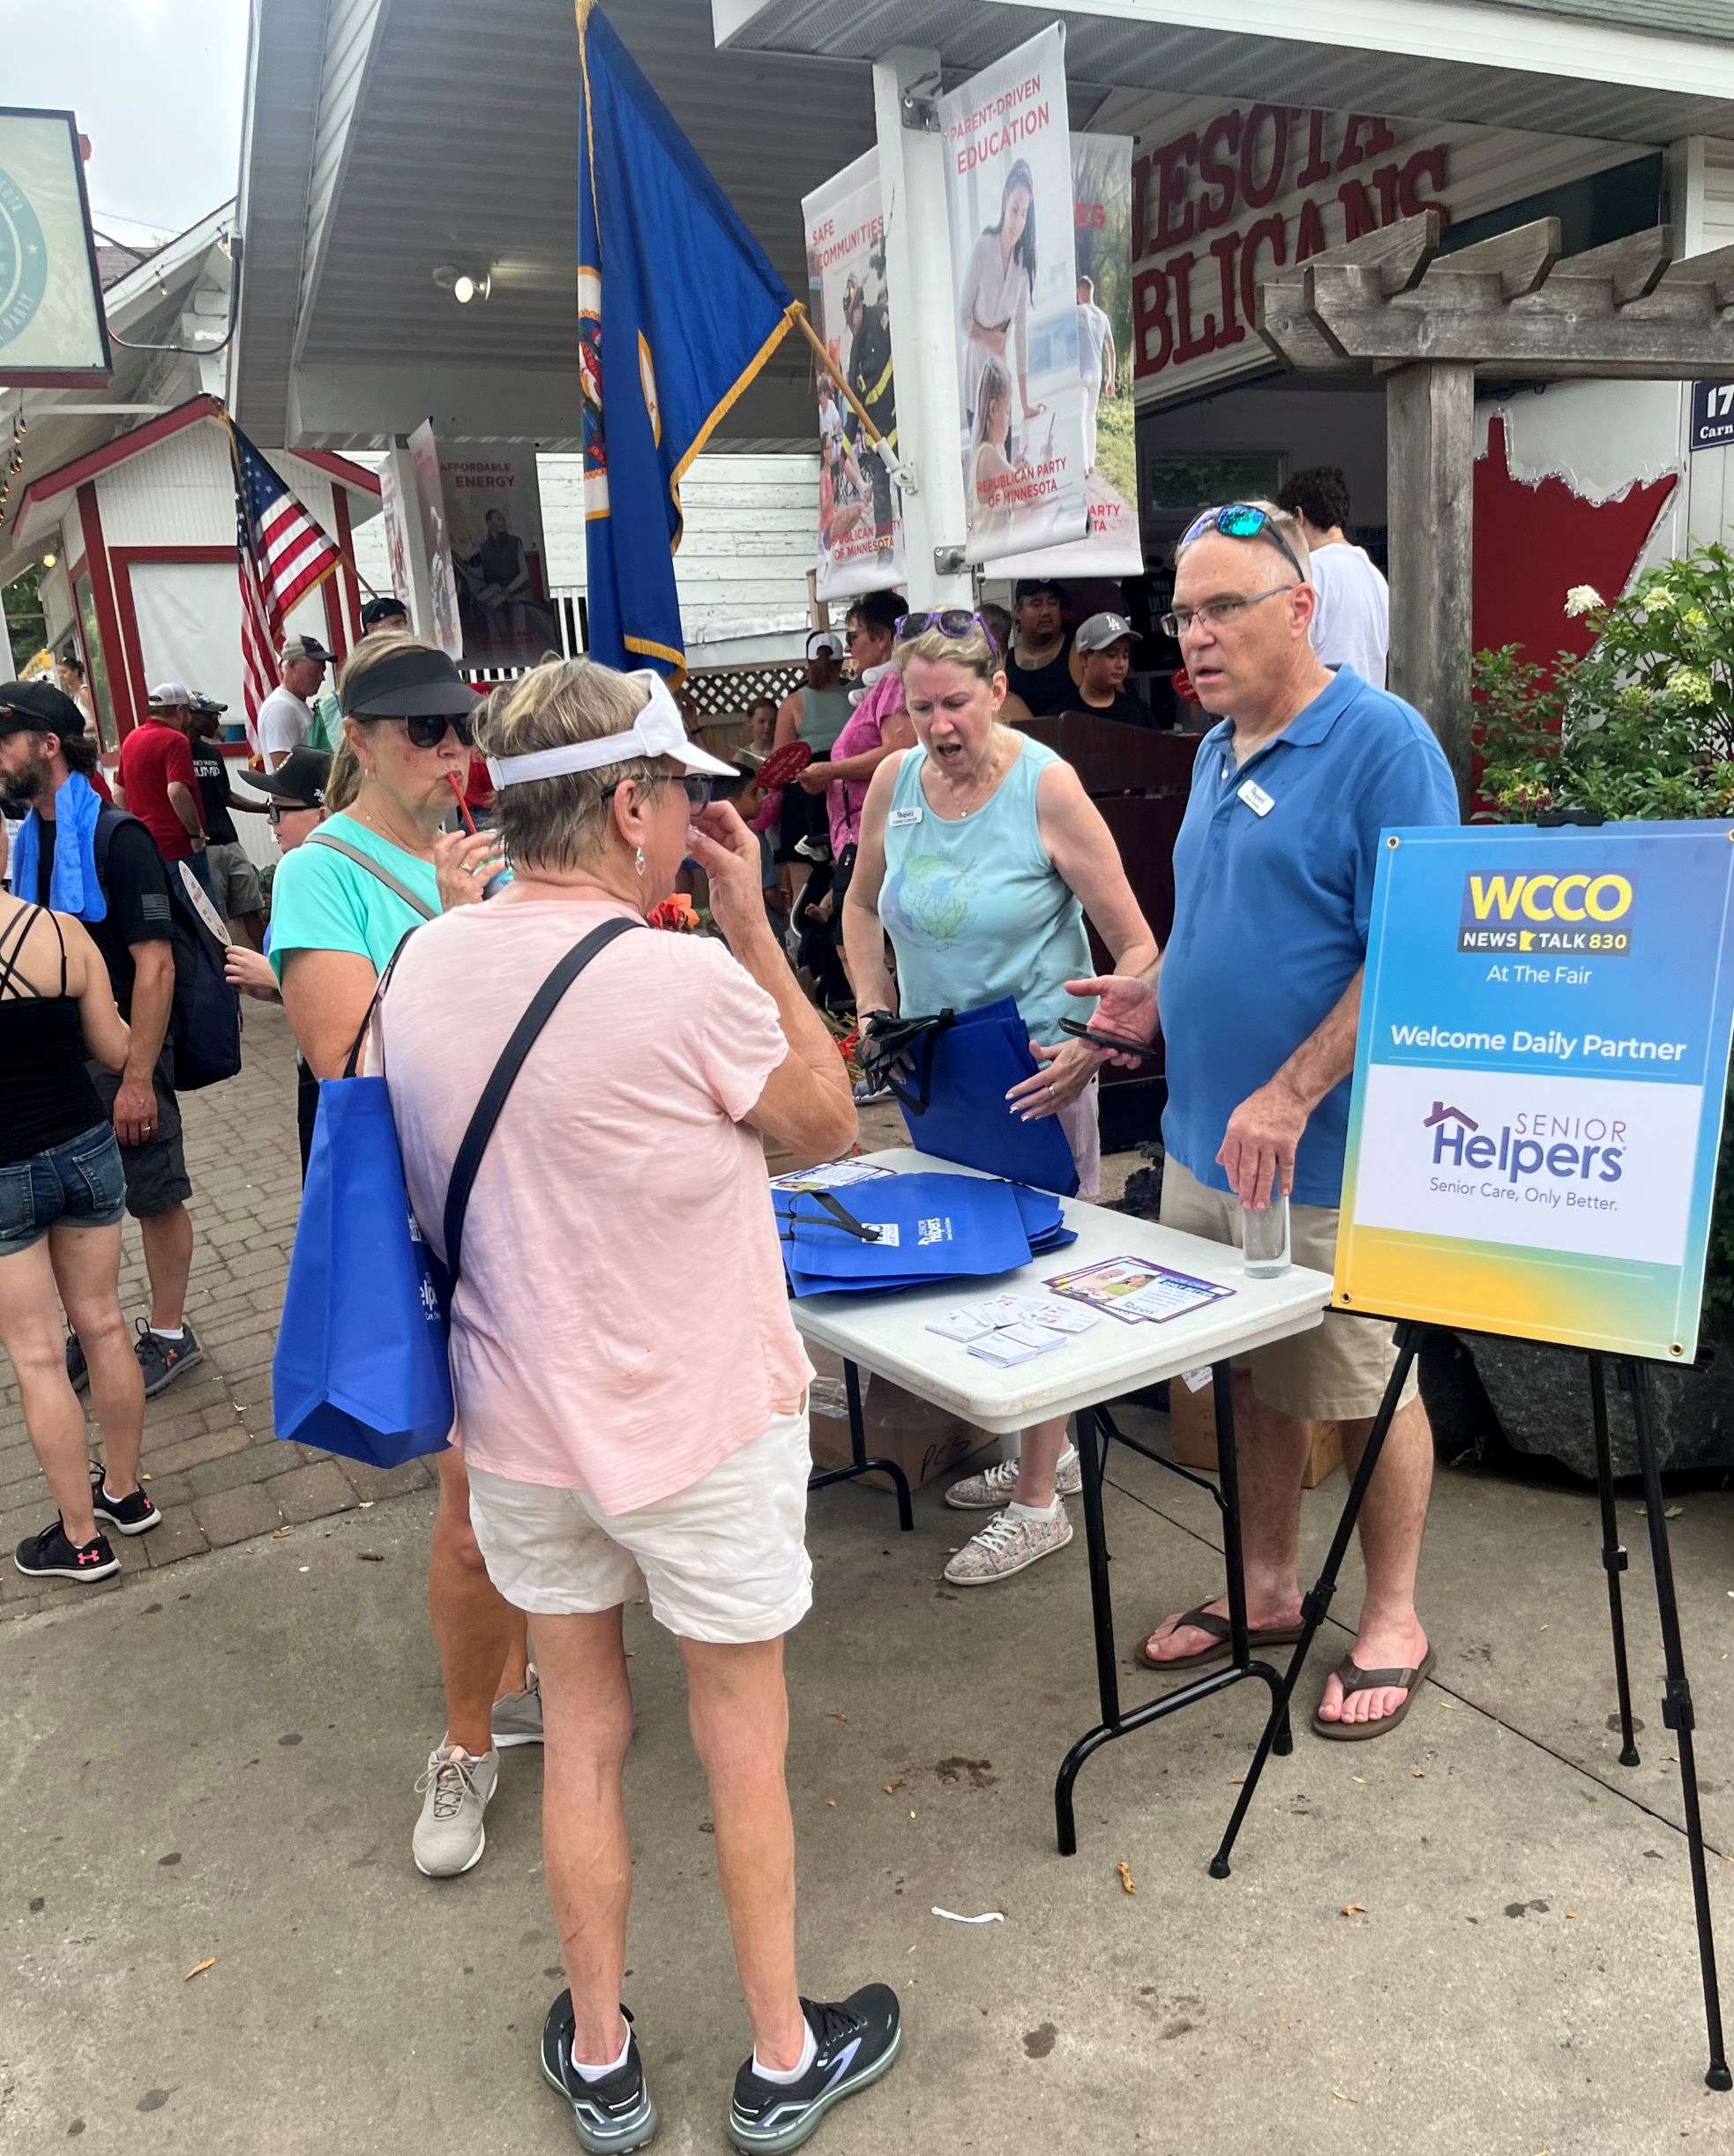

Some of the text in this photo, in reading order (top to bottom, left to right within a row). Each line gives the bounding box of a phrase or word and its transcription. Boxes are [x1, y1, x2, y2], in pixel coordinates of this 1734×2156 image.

[950, 74, 1041, 141] PARENT-DRIVEN
[957, 101, 1050, 175] EDUCATION
[812, 219, 834, 247] SAFE
[816, 215, 884, 272] COMMUNITIES
[1707, 384, 1734, 418] 17
[1700, 424, 1734, 439] Carn
[441, 463, 511, 472] AFFORDABLE
[455, 475, 515, 488] ENERGY
[976, 457, 1066, 494] REPUBLICAN PARTY
[988, 479, 1058, 509] OF MINNESOTA
[1089, 504, 1121, 518] ARTY
[834, 535, 894, 561] OF MINNESOTA
[1105, 615, 1121, 630] LA
[1469, 874, 1633, 921] WCCO
[1463, 931, 1627, 950] NEWS TALK 830
[1486, 965, 1593, 984] At The Fair
[1391, 1025, 1686, 1061] Welcome Daily Partner
[1514, 1113, 1626, 1143] SENIOR
[1432, 1123, 1624, 1183] Helpers
[1430, 1177, 1618, 1211] Senior Care, Only Better.
